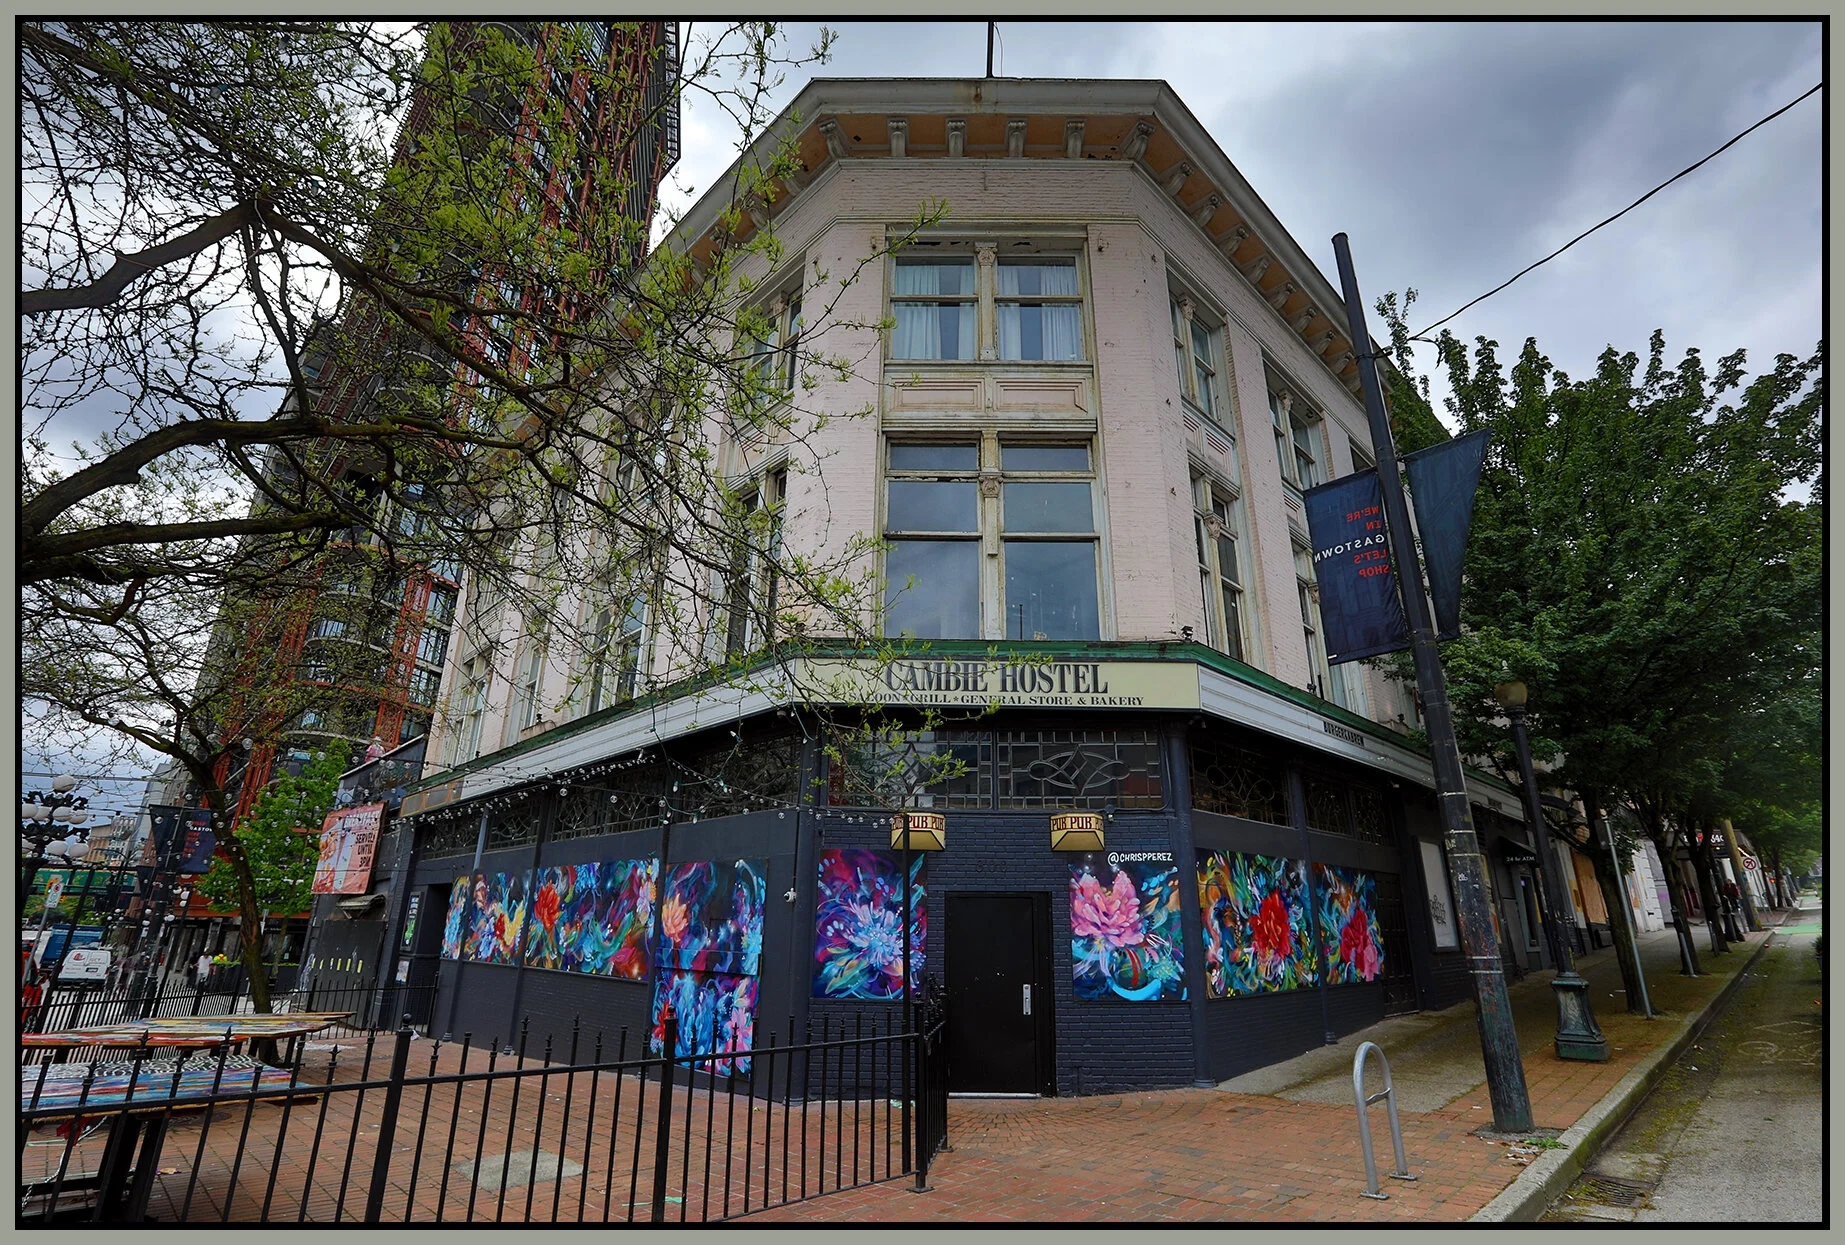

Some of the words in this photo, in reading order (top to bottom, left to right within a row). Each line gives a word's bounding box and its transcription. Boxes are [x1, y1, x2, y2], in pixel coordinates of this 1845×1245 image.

[885, 661, 989, 693] CAMBIE
[997, 662, 1109, 694] HOSTEL
[849, 691, 901, 703] SOON
[910, 693, 952, 703] GRILL
[960, 694, 1026, 705] GENERAL
[1029, 695, 1073, 705] STORE
[1077, 696, 1087, 705] &
[1090, 695, 1144, 706] BAKERY
[931, 816, 944, 831] PUB
[1052, 816, 1067, 831] PUB
[1070, 815, 1092, 829] PUB
[1107, 851, 1173, 867] @CHRISPPEREZ
